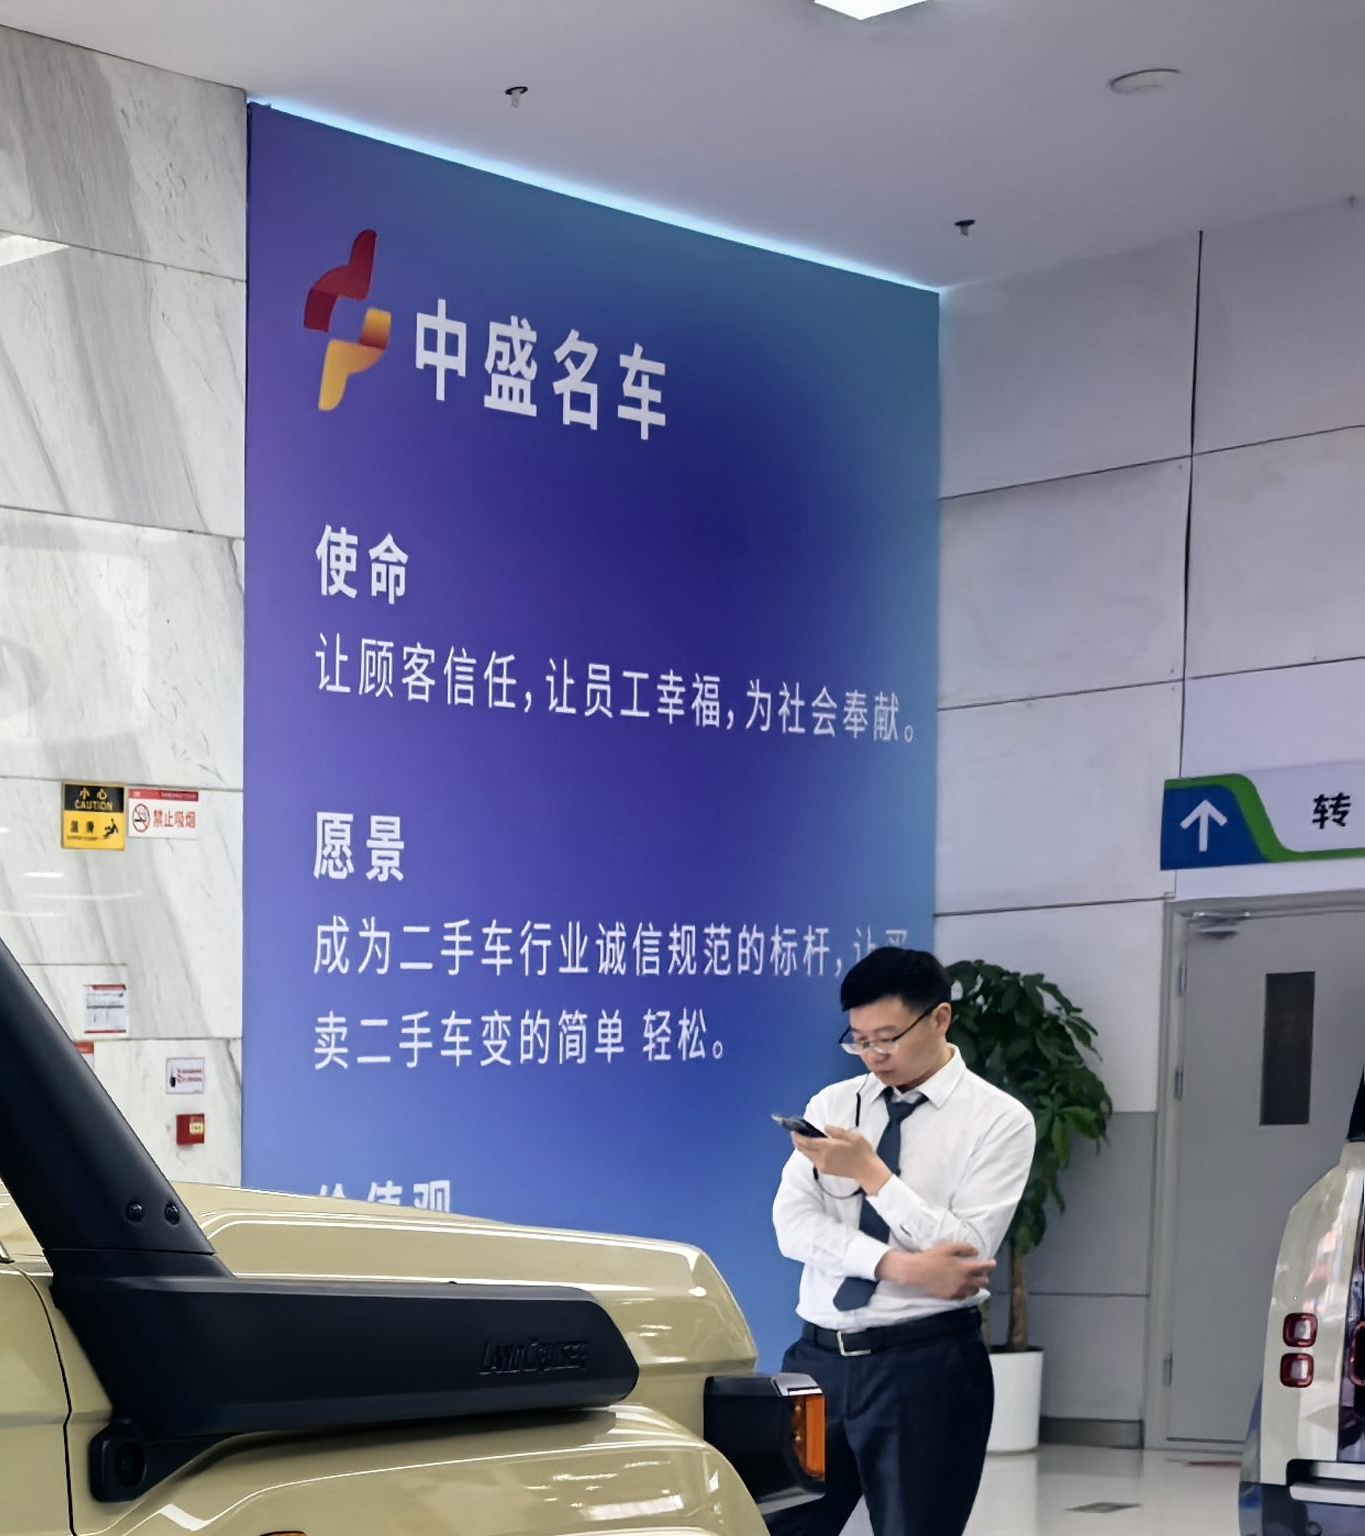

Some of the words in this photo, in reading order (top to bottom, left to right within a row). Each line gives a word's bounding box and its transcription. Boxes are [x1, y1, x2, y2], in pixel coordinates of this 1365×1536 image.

[415, 299, 666, 441] 中盛名车
[315, 525, 409, 604] 使命
[74, 800, 113, 812] CAUTION
[152, 809, 196, 829] 禁止吸烟
[1312, 792, 1352, 829] 转
[313, 811, 406, 882] 愿景
[314, 1008, 626, 1071] 卖二手车变的简单
